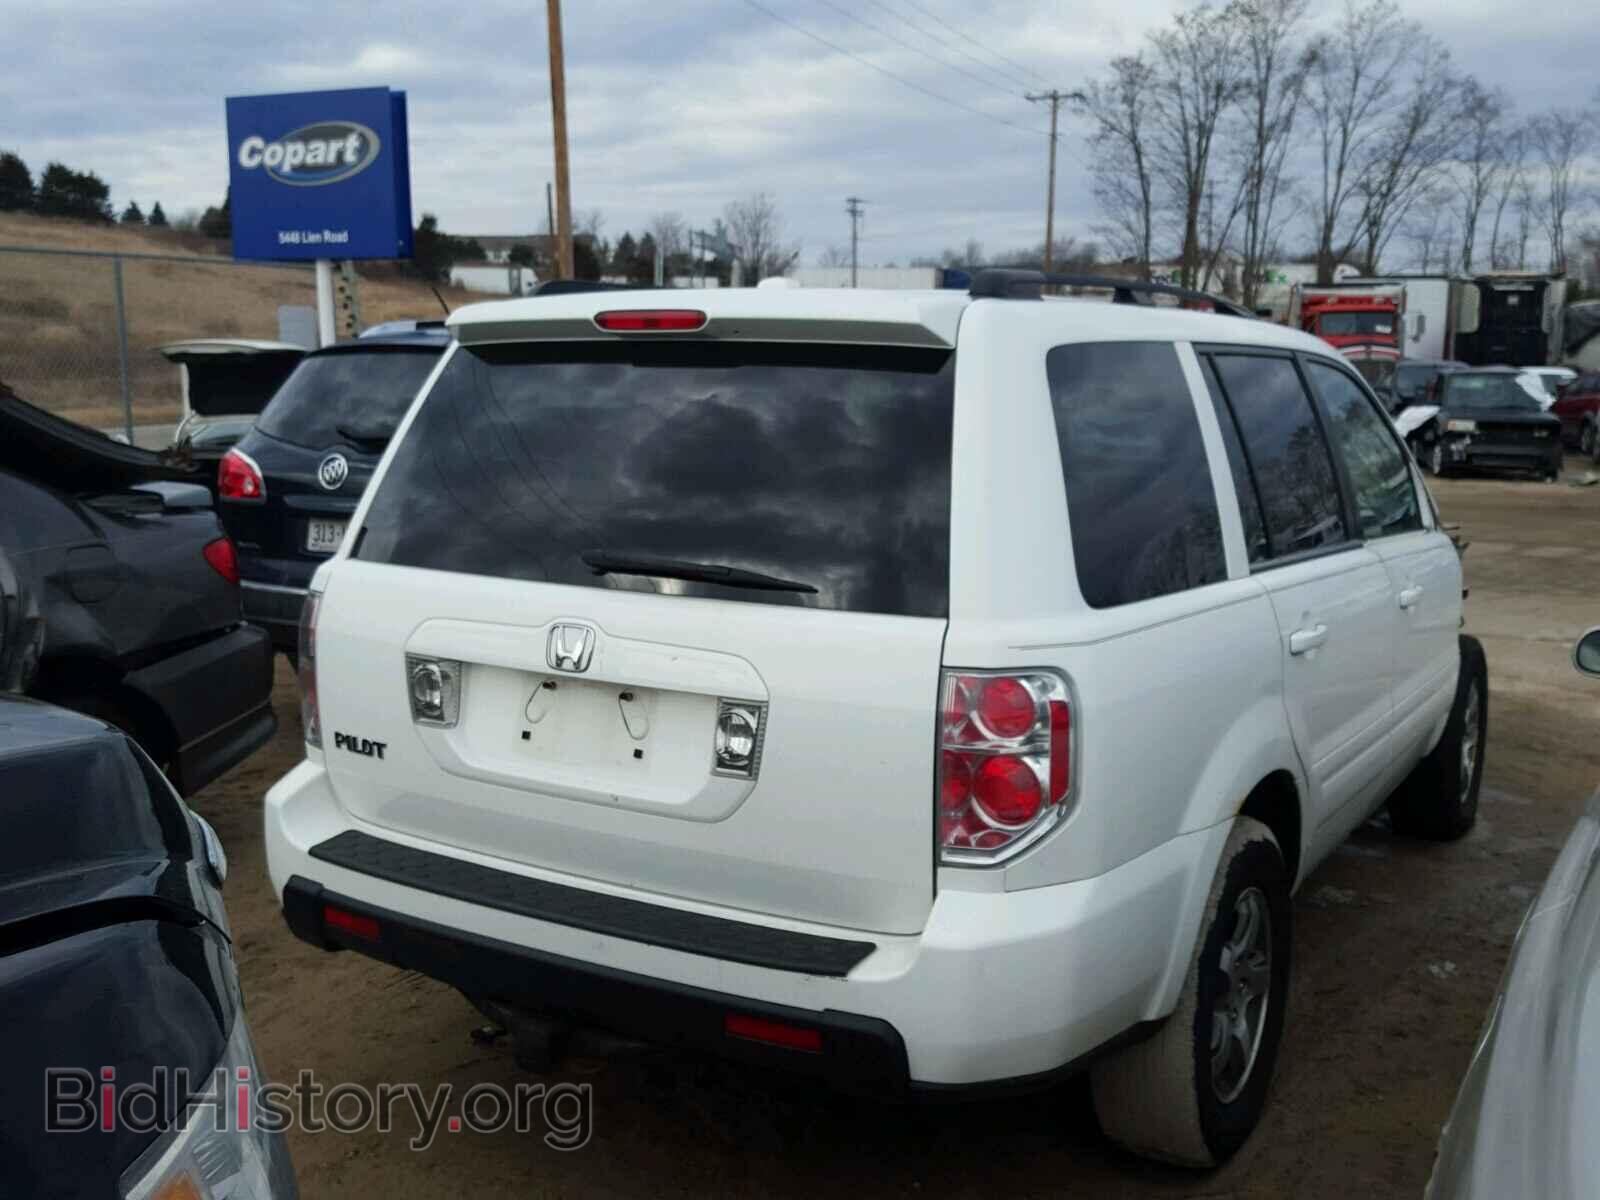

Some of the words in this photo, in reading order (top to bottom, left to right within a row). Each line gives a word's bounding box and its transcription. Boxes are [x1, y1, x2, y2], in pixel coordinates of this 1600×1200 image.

[238, 131, 361, 173] Copart
[302, 230, 321, 244] Lien
[323, 229, 349, 243] Road
[334, 731, 387, 760] PILOT
